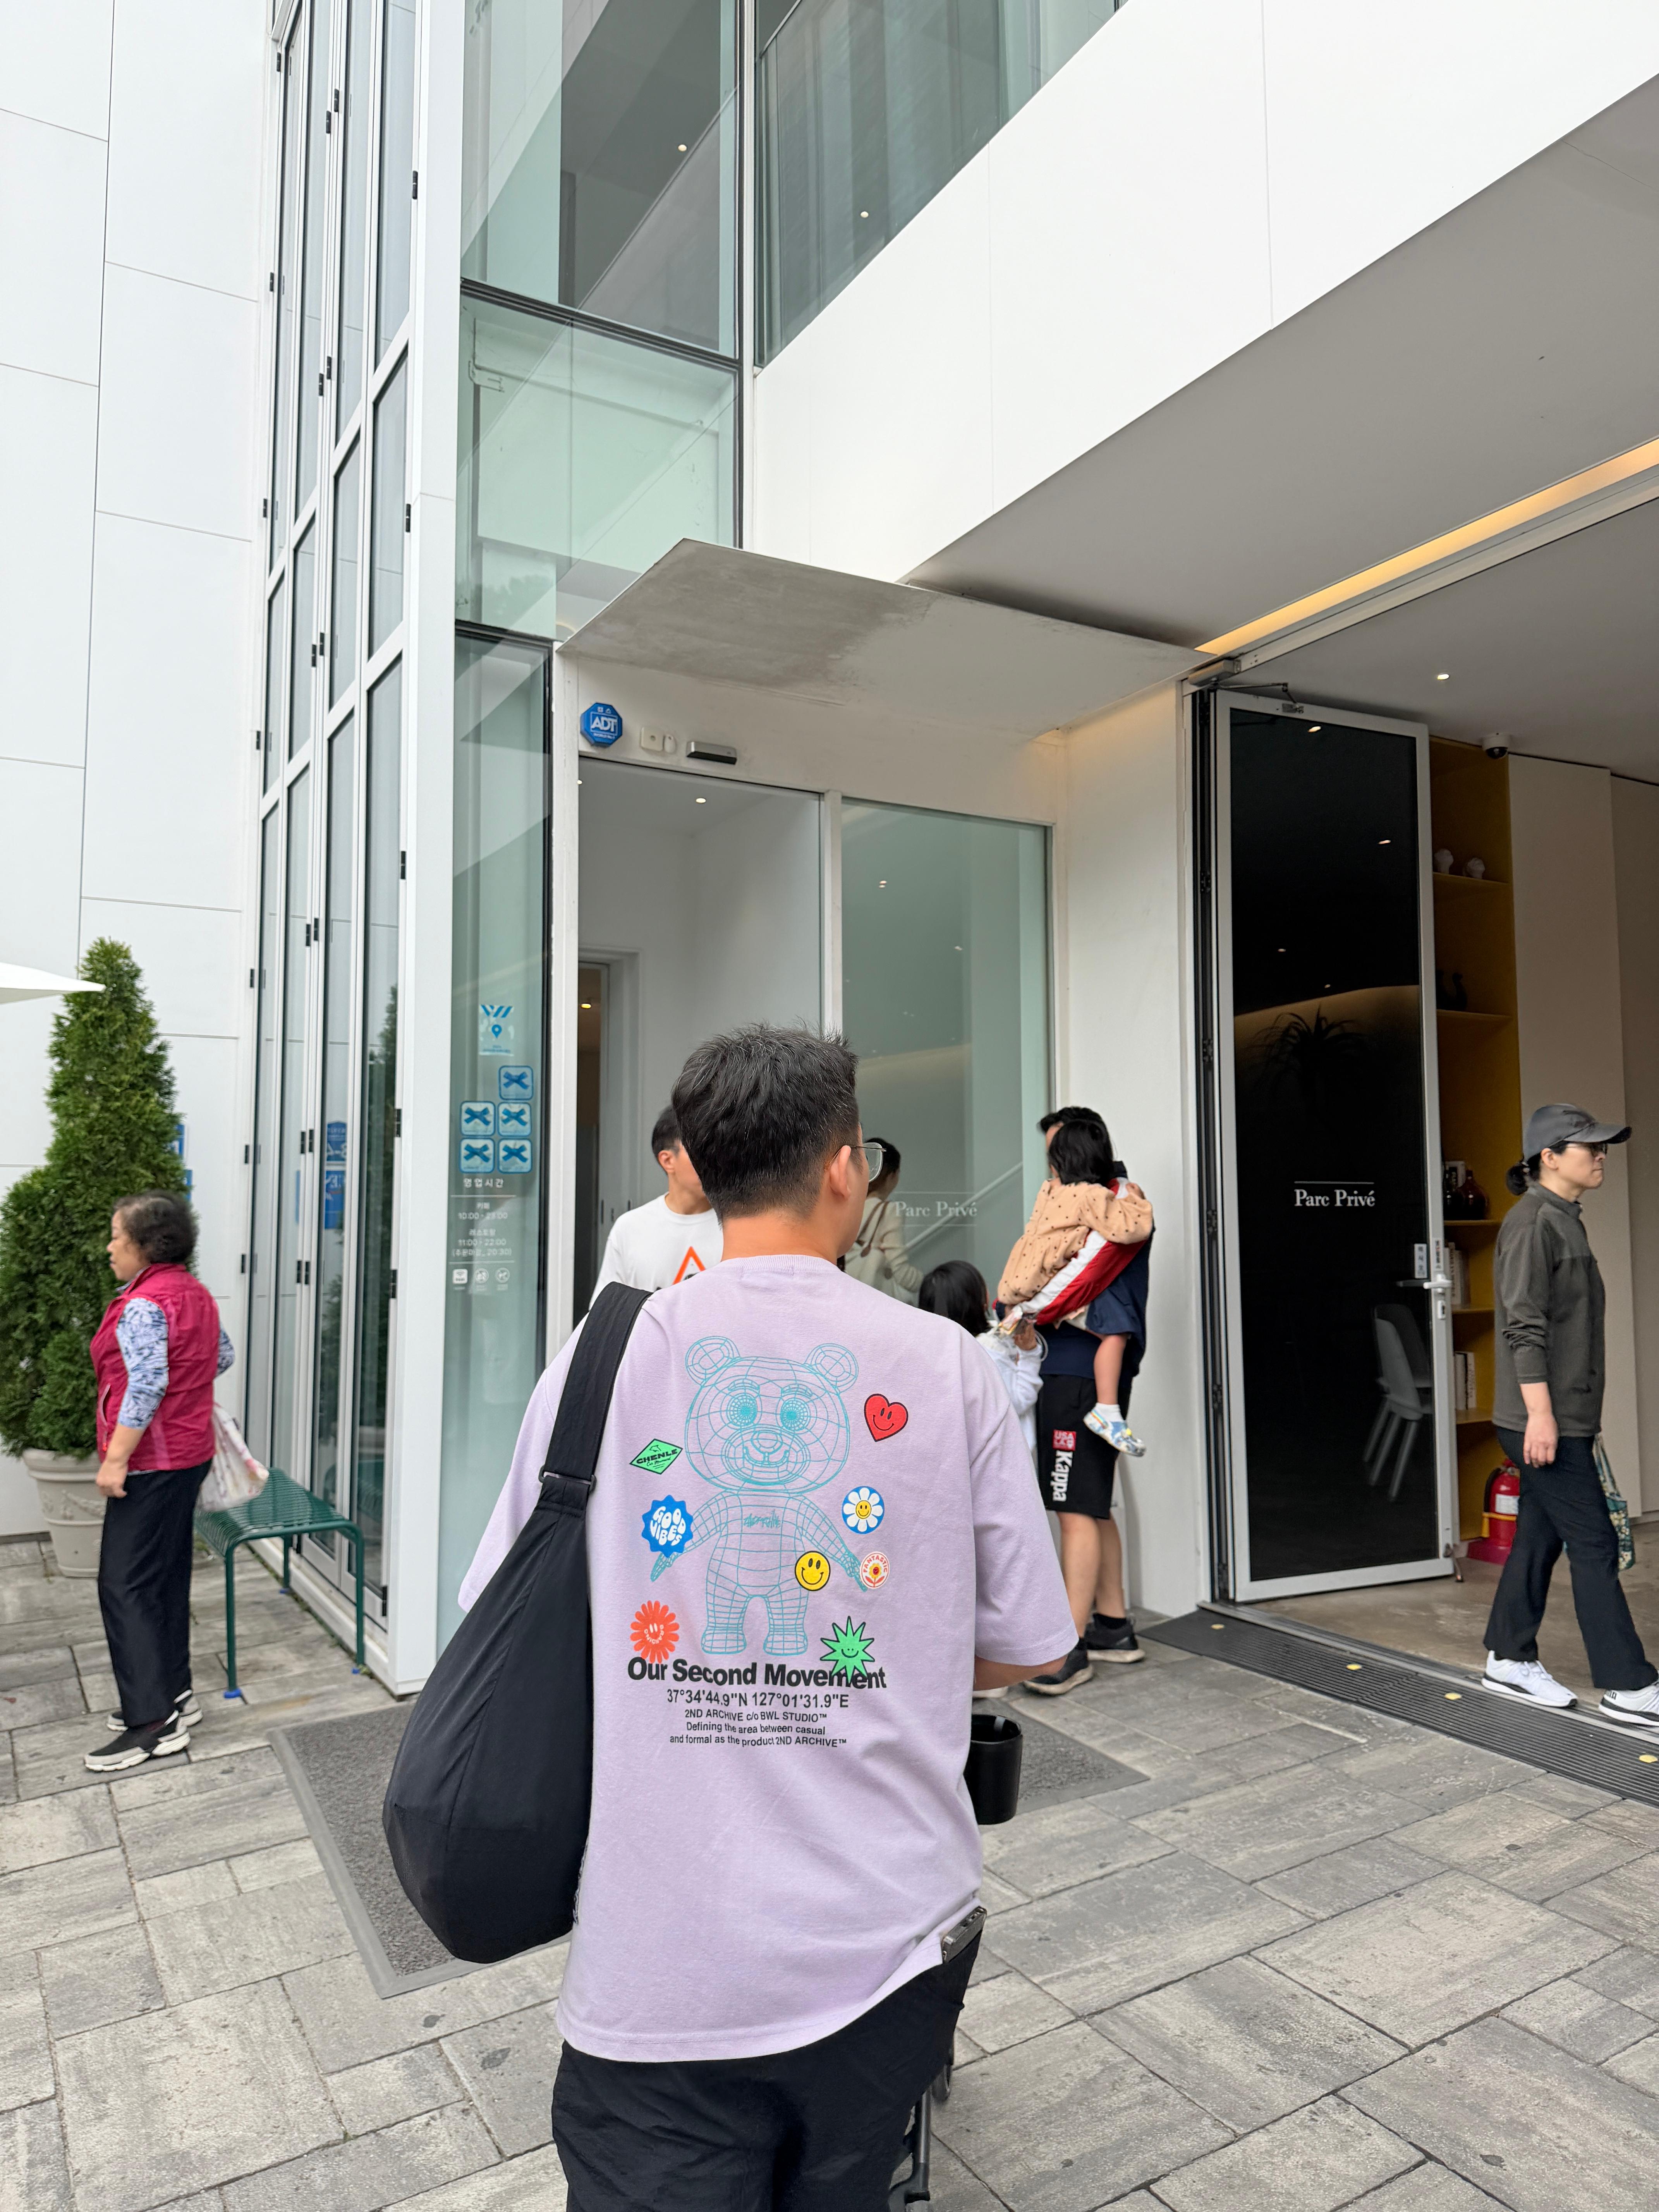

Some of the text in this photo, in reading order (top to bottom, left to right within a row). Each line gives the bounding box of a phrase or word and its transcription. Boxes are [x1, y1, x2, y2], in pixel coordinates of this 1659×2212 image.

[591, 716, 618, 732] ADT
[463, 1178, 503, 1188] 영업시간
[1294, 1189, 1375, 1207] Parc Privé
[895, 1201, 977, 1217] Parc Privé
[636, 1449, 678, 1464] CHENLE
[1050, 1450, 1073, 1502] Kappa
[653, 1506, 686, 1534] GOOD
[650, 1520, 682, 1546] VIBES
[863, 1555, 887, 1573] FANTASTIC
[628, 1657, 887, 1689] Our Second Movement
[685, 1709, 703, 1718] 2ND
[706, 1709, 744, 1721] ARCHIVE
[747, 1712, 758, 1721] c/o
[761, 1711, 780, 1720] BWL
[687, 1722, 722, 1733] Defining
[725, 1723, 736, 1732] the
[760, 1724, 793, 1732] between
[796, 1726, 825, 1735] casual
[670, 1735, 684, 1743] and
[686, 1734, 712, 1743] formal
[728, 1735, 740, 1744] the
[742, 1737, 774, 1747] product
[776, 1736, 792, 1745] 2ND
